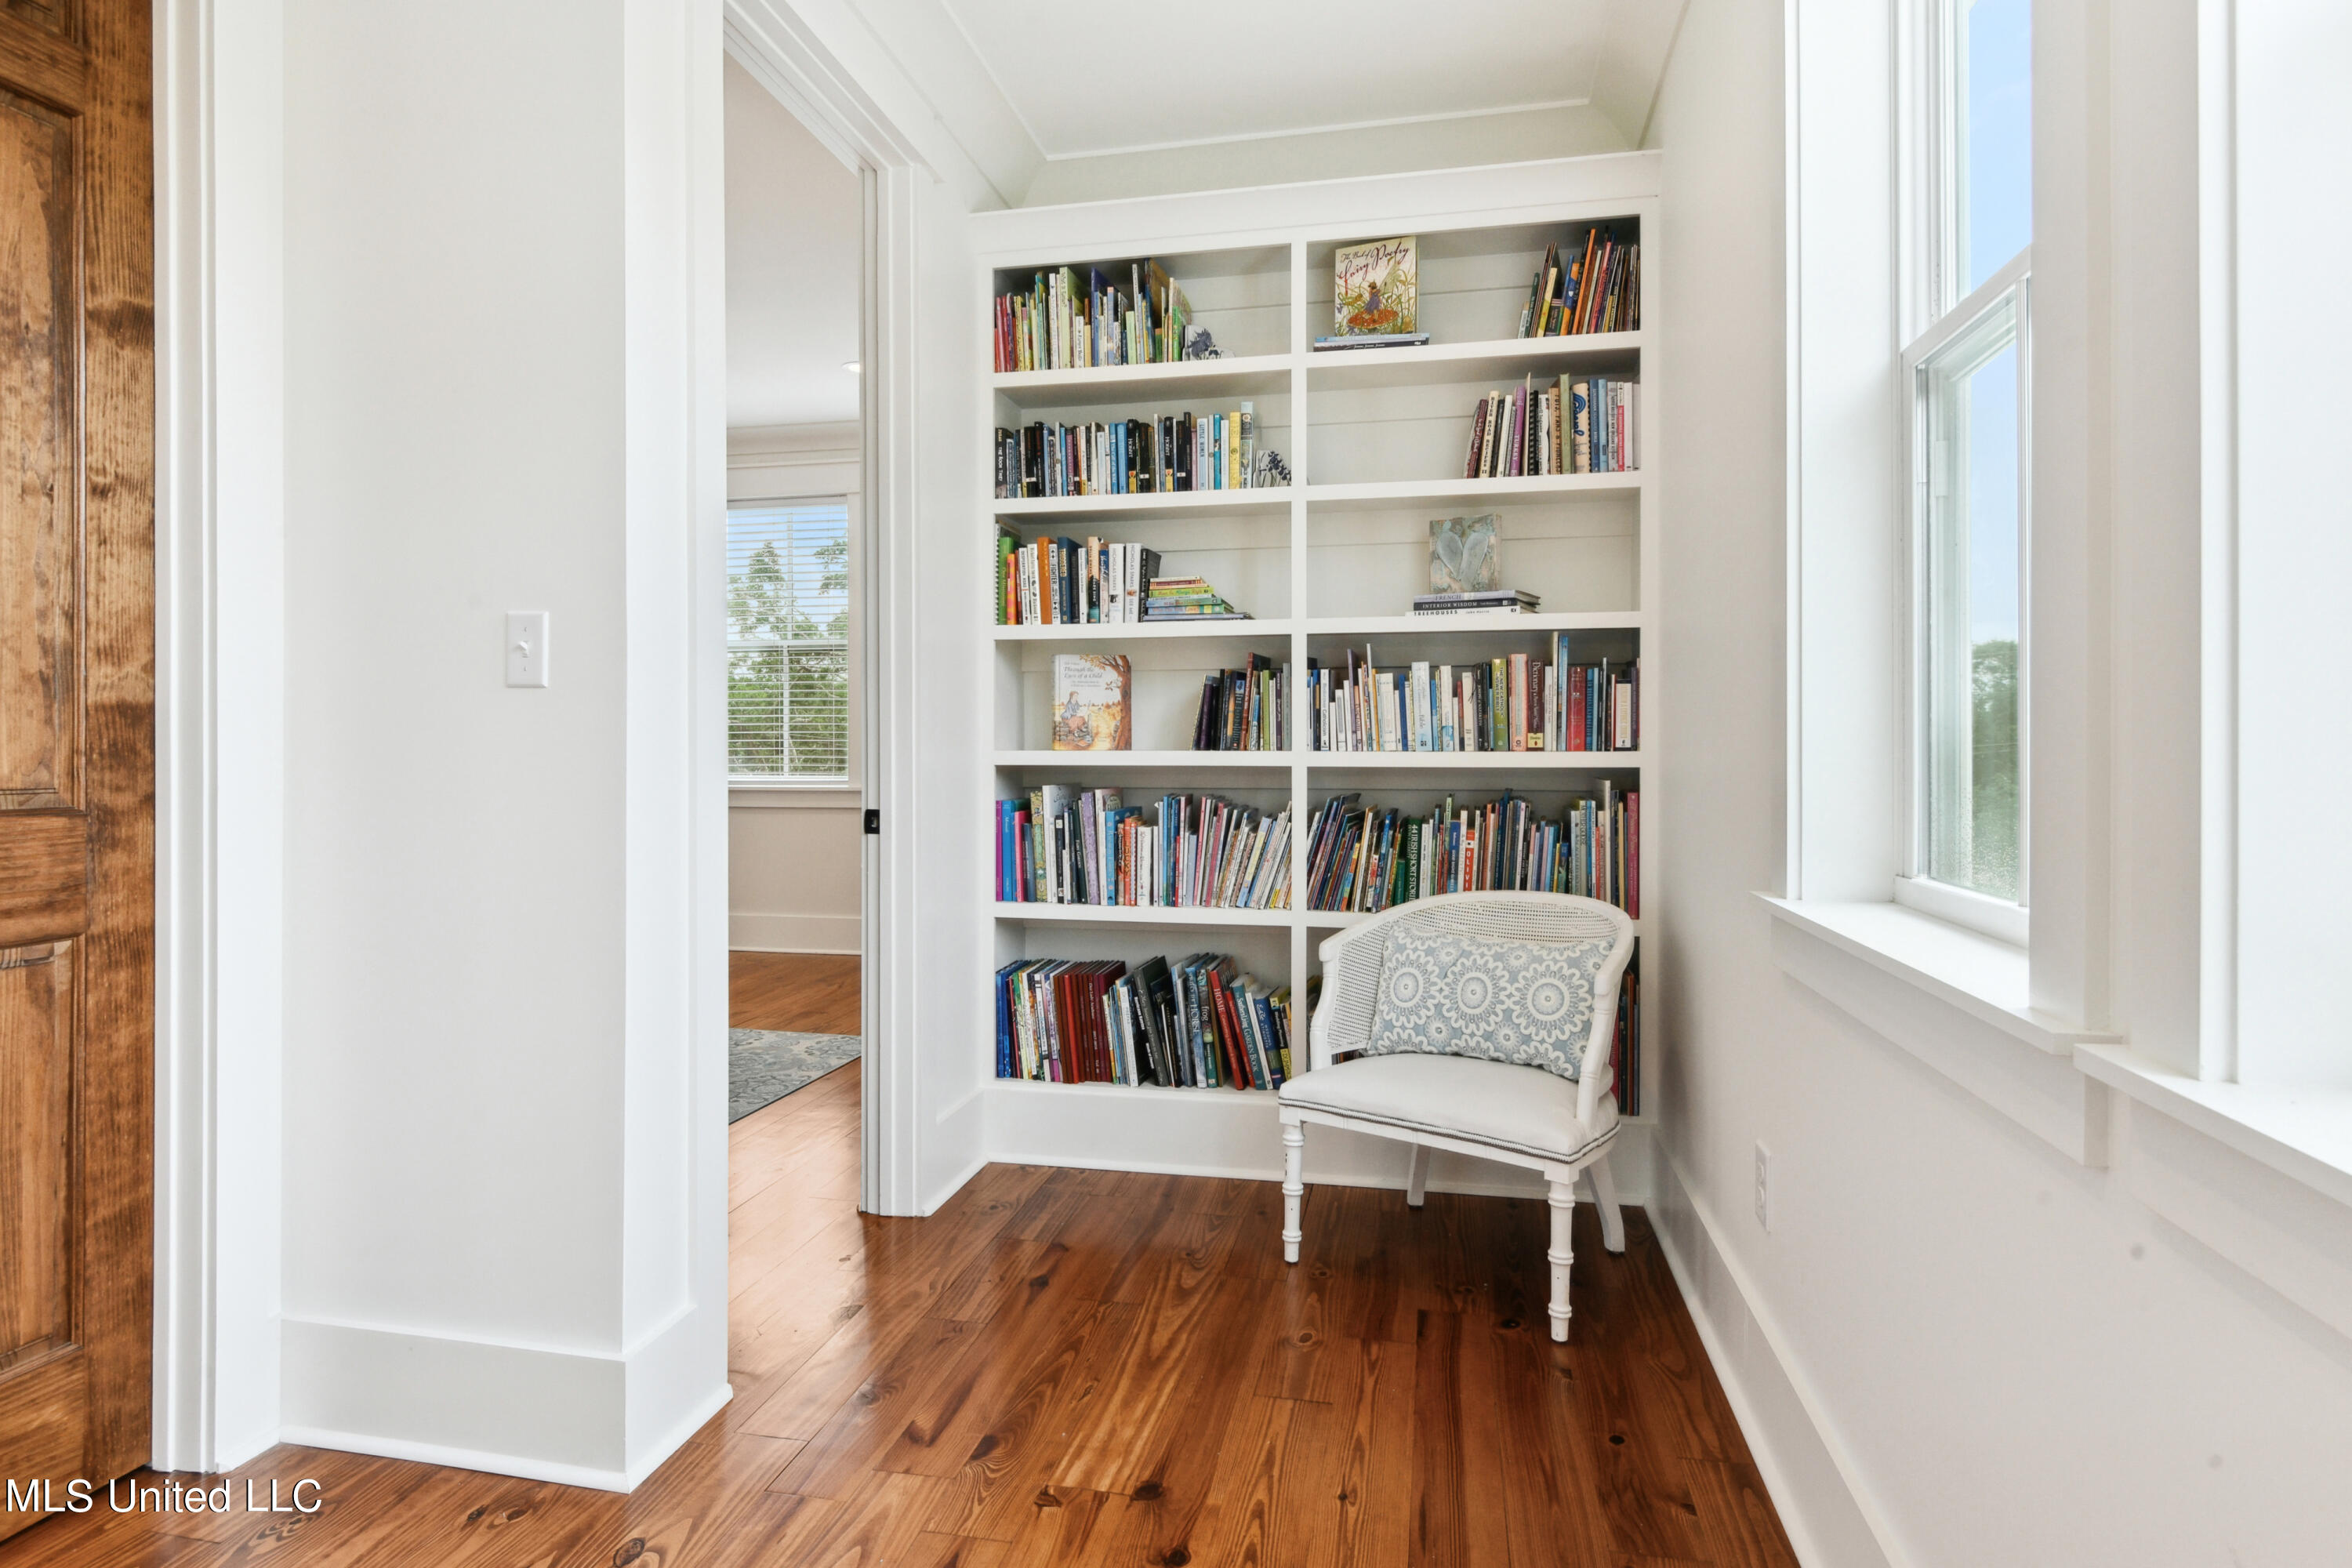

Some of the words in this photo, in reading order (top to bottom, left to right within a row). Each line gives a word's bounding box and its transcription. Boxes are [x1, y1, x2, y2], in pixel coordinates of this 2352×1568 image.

[1341, 252, 1351, 264] The
[1352, 251, 1363, 260] Book
[1370, 241, 1410, 270] Poetry
[1531, 662, 1541, 693] Dictionary
[1411, 824, 1417, 833] 44
[1134, 996, 1143, 1015] Hurricane
[1214, 988, 1225, 1013] HOME
[1237, 997, 1246, 1016] Southern
[1190, 1004, 1200, 1035] HORSE
[1201, 1005, 1210, 1021] frog
[1240, 1016, 1249, 1029] Living
[1243, 1029, 1253, 1053] GARDEN
[1248, 1054, 1258, 1073] BOOK
